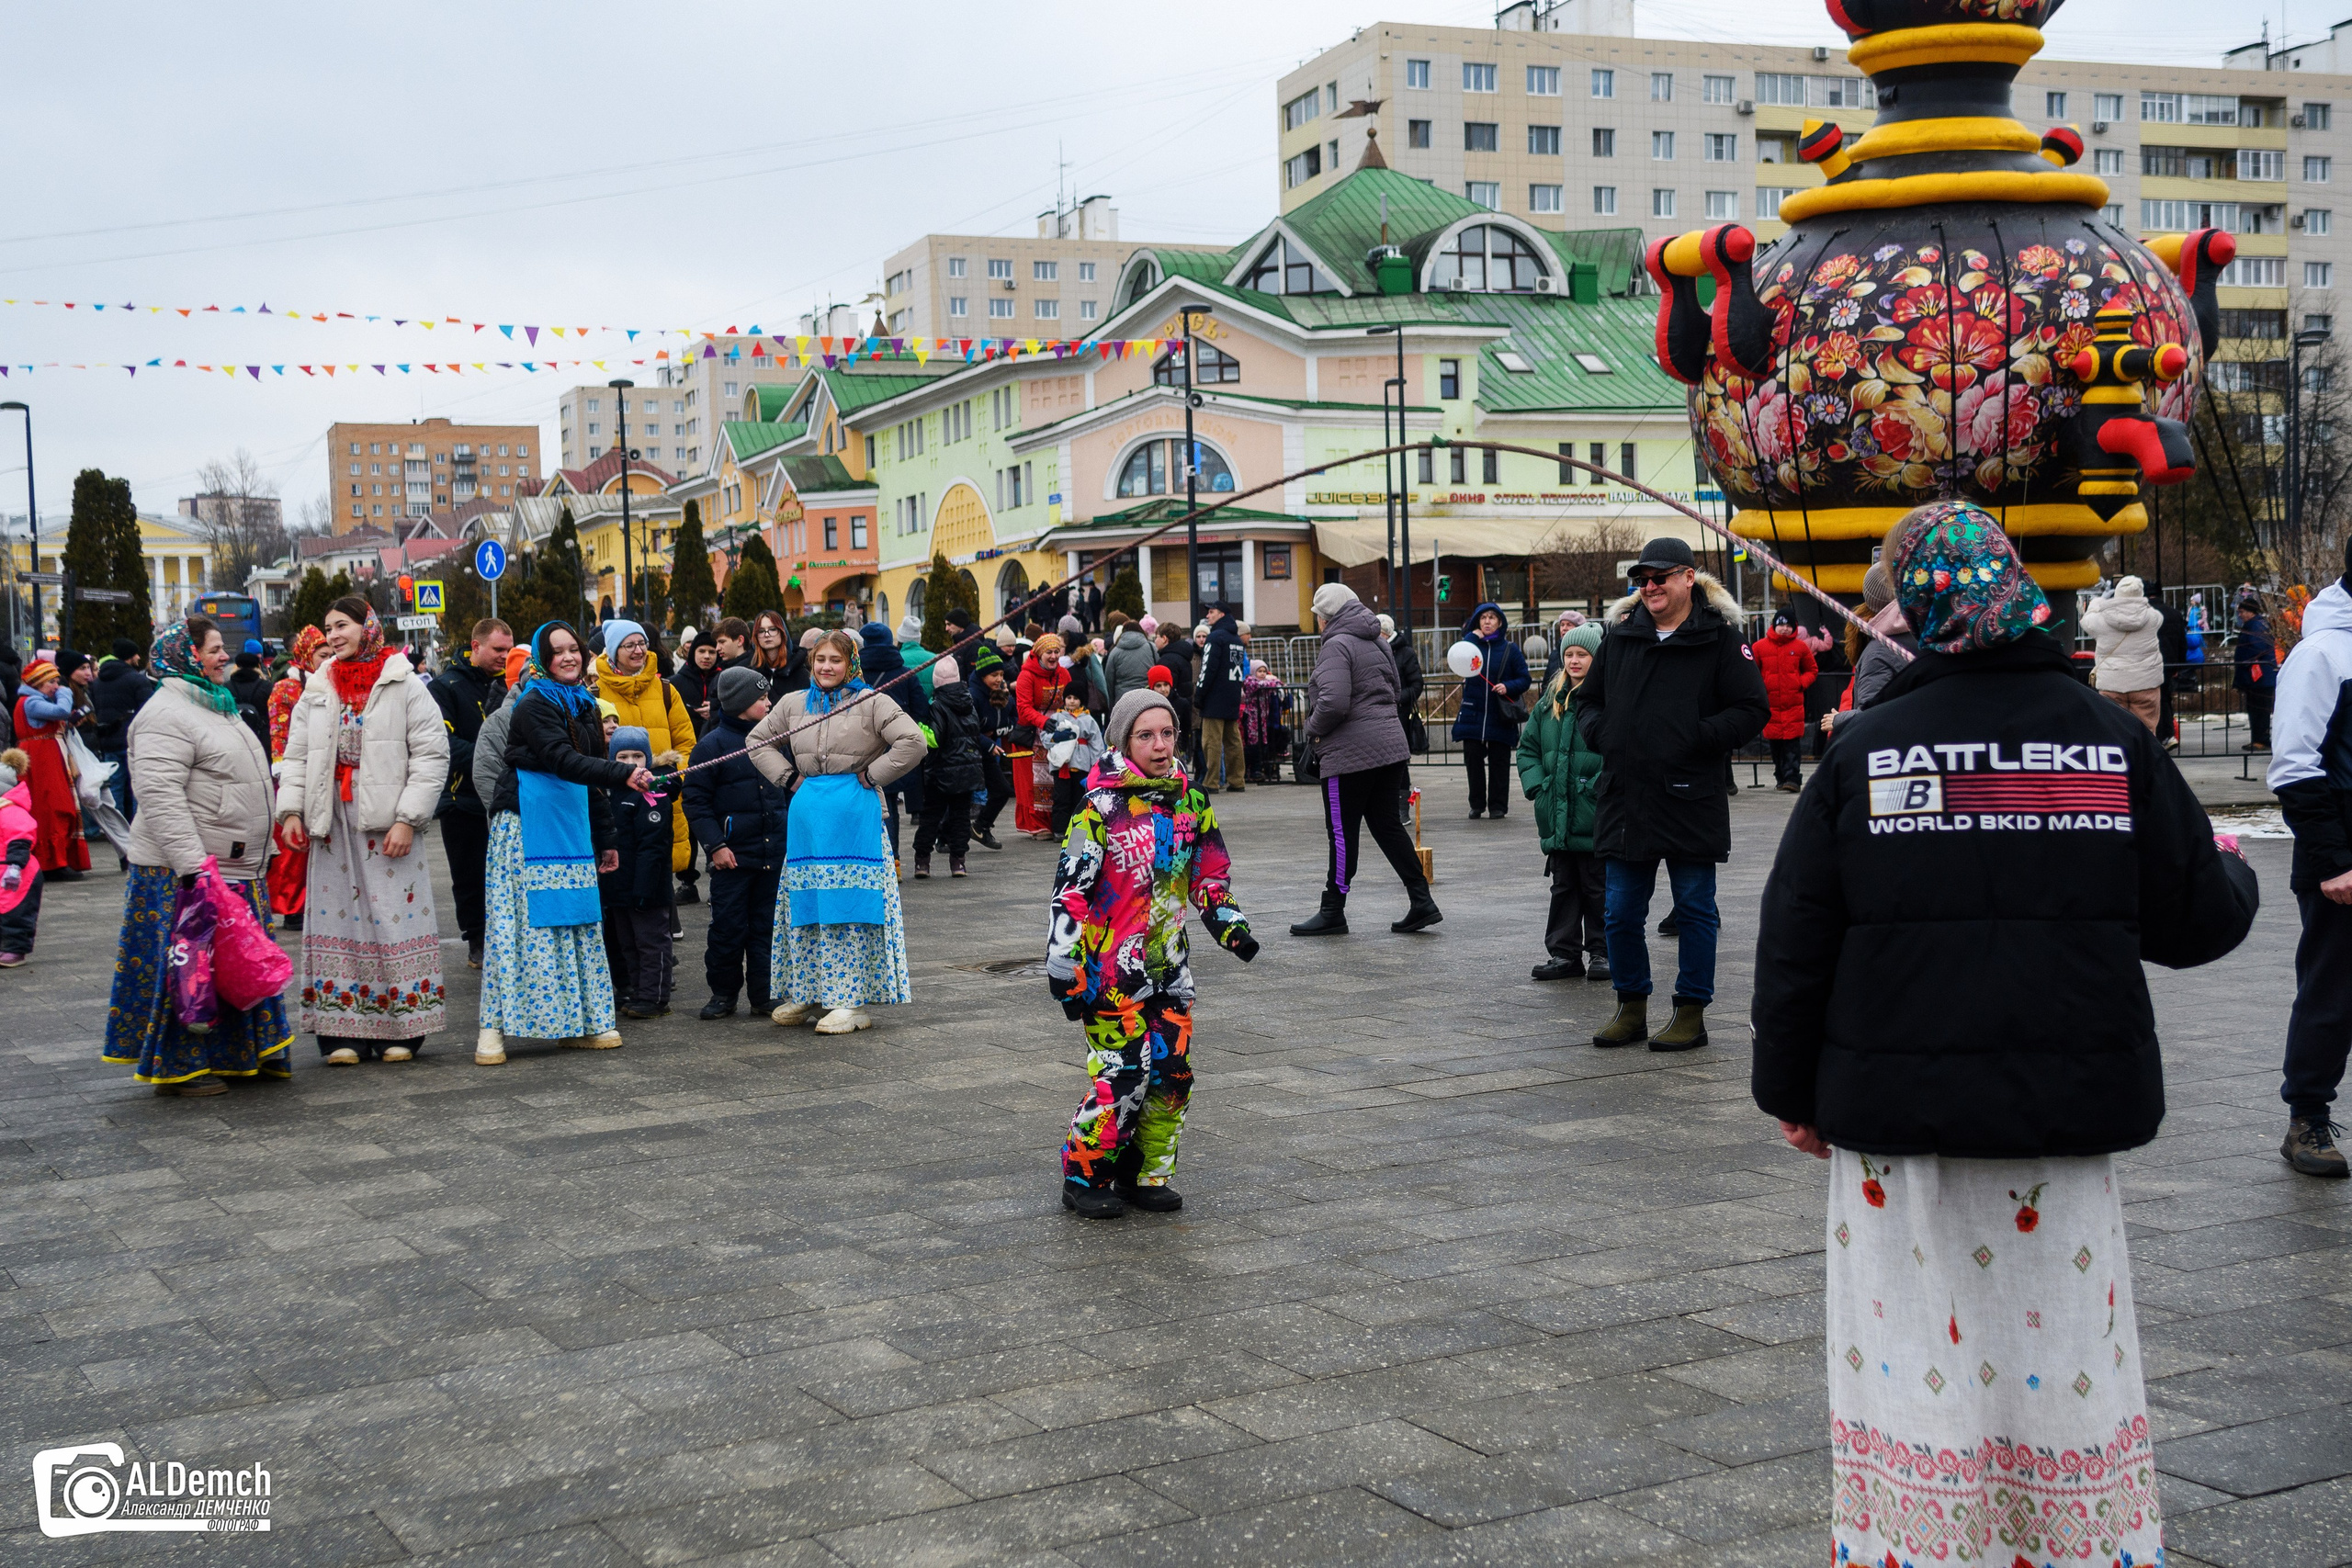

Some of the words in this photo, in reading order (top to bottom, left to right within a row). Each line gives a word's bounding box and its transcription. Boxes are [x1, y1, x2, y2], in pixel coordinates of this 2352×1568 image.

[1306, 491, 1363, 504] JUICE
[1493, 492, 1537, 505] ОБУВЬ
[1540, 492, 1608, 506] ПЕШЕХОД
[401, 617, 431, 628] СТОП
[1868, 742, 2129, 777] BATTLEKID
[1903, 779, 1931, 810] B
[1868, 815, 1973, 835] WORLD
[1979, 814, 2041, 830] BKID
[2048, 814, 2132, 832] MADE
